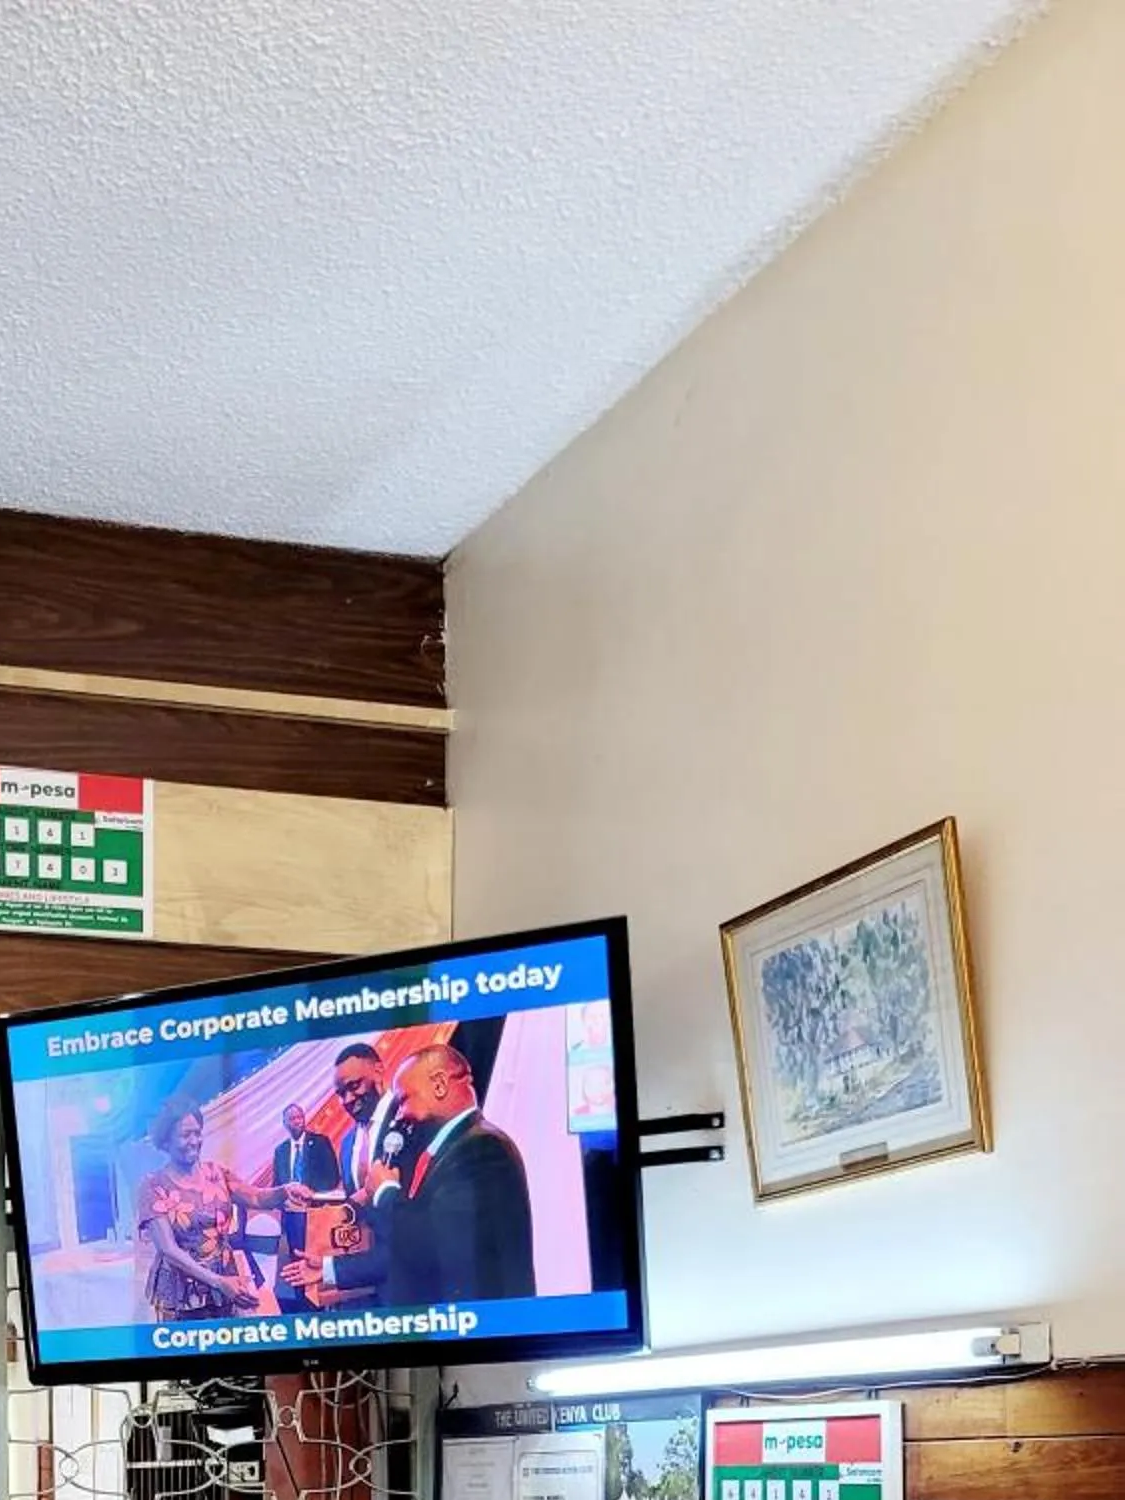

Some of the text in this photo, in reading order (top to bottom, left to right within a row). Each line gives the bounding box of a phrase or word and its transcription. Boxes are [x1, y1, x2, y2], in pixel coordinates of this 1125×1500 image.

[47, 963, 563, 1057] Embrace Corporate Membership today
[152, 1304, 477, 1350] Corporate Membership
[592, 1402, 620, 1421] CLUB
